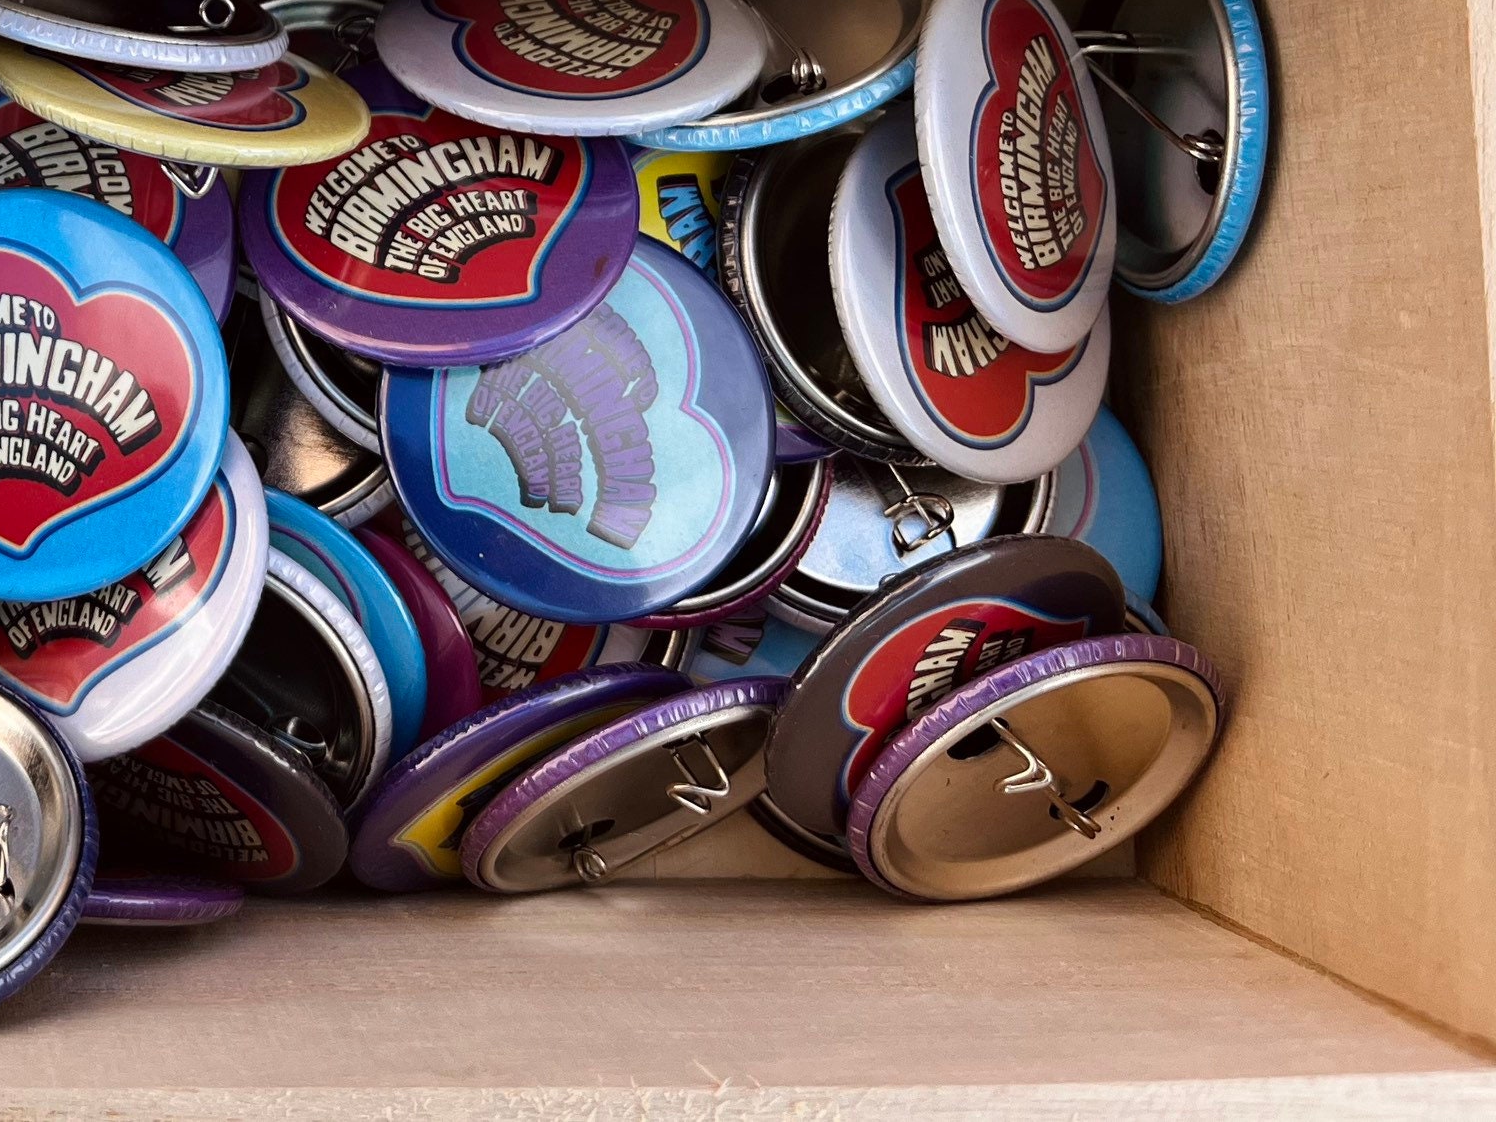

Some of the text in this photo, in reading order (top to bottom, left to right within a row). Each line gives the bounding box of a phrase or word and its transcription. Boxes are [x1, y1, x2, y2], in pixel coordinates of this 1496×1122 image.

[502, 32, 623, 79] WELCOME
[584, 12, 624, 31] BIG
[618, 24, 665, 43] THE
[650, 16, 673, 30] OF
[306, 134, 421, 235] WELCOME TO
[1016, 36, 1062, 267] BIRMINGHAM
[1046, 93, 1074, 253] THE BIG HEART
[1061, 119, 1085, 241] OF ENGLAND
[330, 135, 552, 264] BIRMINGHAM
[999, 111, 1035, 270] WELCOME TO
[384, 189, 526, 271] THE BIG HEART
[418, 214, 524, 278] OF ENGLAND
[29, 301, 56, 330] TO
[931, 276, 960, 308] ART
[27, 402, 99, 463] HEART
[495, 401, 550, 495] ENGLAND
[523, 376, 567, 428] BIG
[550, 423, 582, 502] HEART
[8, 601, 117, 648] OF ENGLAND
